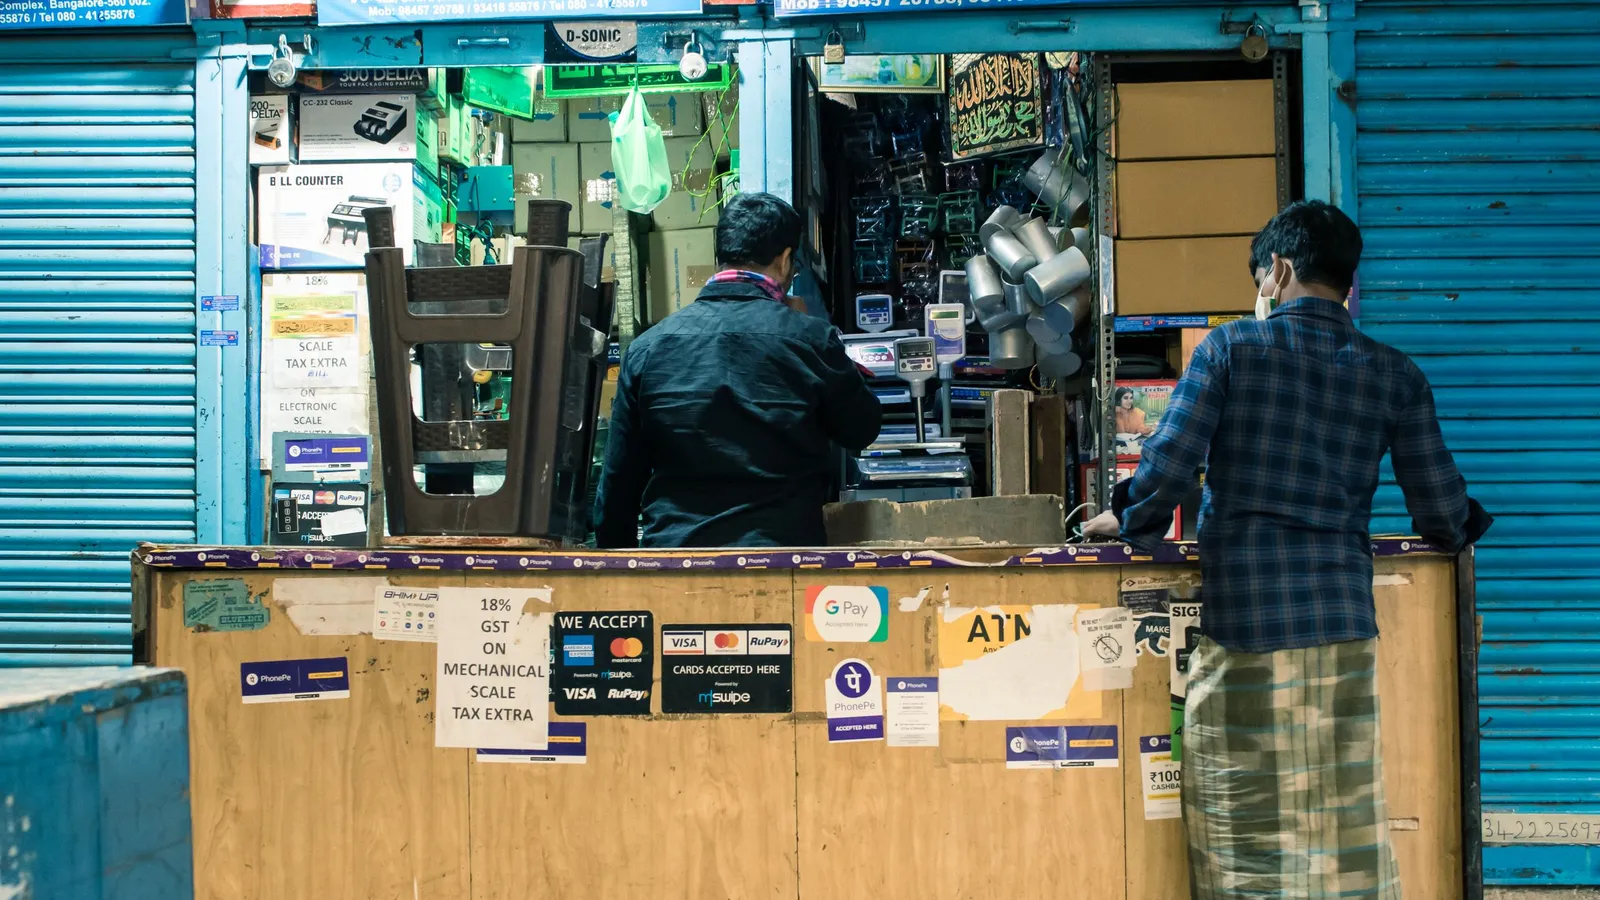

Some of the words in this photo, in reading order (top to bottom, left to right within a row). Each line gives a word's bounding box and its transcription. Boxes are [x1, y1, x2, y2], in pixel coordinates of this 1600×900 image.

[368, 6, 394, 16] Mob:
[398, 5, 429, 16] 98457
[550, 1, 564, 10] Tel
[568, 0, 585, 10] 080
[0, 14, 30, 23] 55876
[39, 12, 54, 22] Tel
[58, 12, 75, 21] 080
[86, 10, 135, 20] 41255876
[566, 29, 621, 42] D-SONIC
[374, 68, 422, 80] DELTA
[252, 101, 268, 110] 200
[252, 110, 281, 118] DELTA
[270, 176, 292, 186] BLL
[296, 175, 344, 186] COUNTER
[305, 276, 328, 286] 18%
[299, 342, 333, 352] SCALE
[286, 358, 307, 368] TAX
[310, 358, 347, 368] EXTRA
[301, 389, 316, 398] ON
[280, 402, 337, 411] ELECTRONIC
[294, 416, 322, 424] SCALE
[1078, 546, 1101, 554] PhonePe
[530, 558, 552, 566] PhonePe
[384, 590, 414, 600] BHIM
[480, 598, 512, 612] 18%
[825, 600, 840, 615] G
[843, 601, 868, 618] Pay
[1172, 606, 1200, 617] SIG
[480, 620, 510, 633] GST
[560, 616, 583, 628] WE
[588, 616, 648, 629] ACCEPT
[1146, 625, 1170, 634] MAKE
[672, 638, 698, 648] VISA
[750, 637, 784, 648] RuPay
[482, 642, 506, 655] ON
[444, 662, 545, 678] MECHANICAL
[673, 665, 704, 674] CARDS
[706, 665, 753, 674] ACCEPTED
[756, 665, 780, 674] HERE
[260, 674, 292, 682] PhonePe
[844, 665, 862, 694] पे
[470, 686, 516, 699] SCALE
[562, 688, 596, 700] VISA
[608, 688, 645, 700] RuPay
[834, 701, 876, 712] PhonePe
[452, 706, 480, 720] TAX
[485, 708, 534, 722] EXTRA
[835, 724, 863, 732] ACCEPTED
